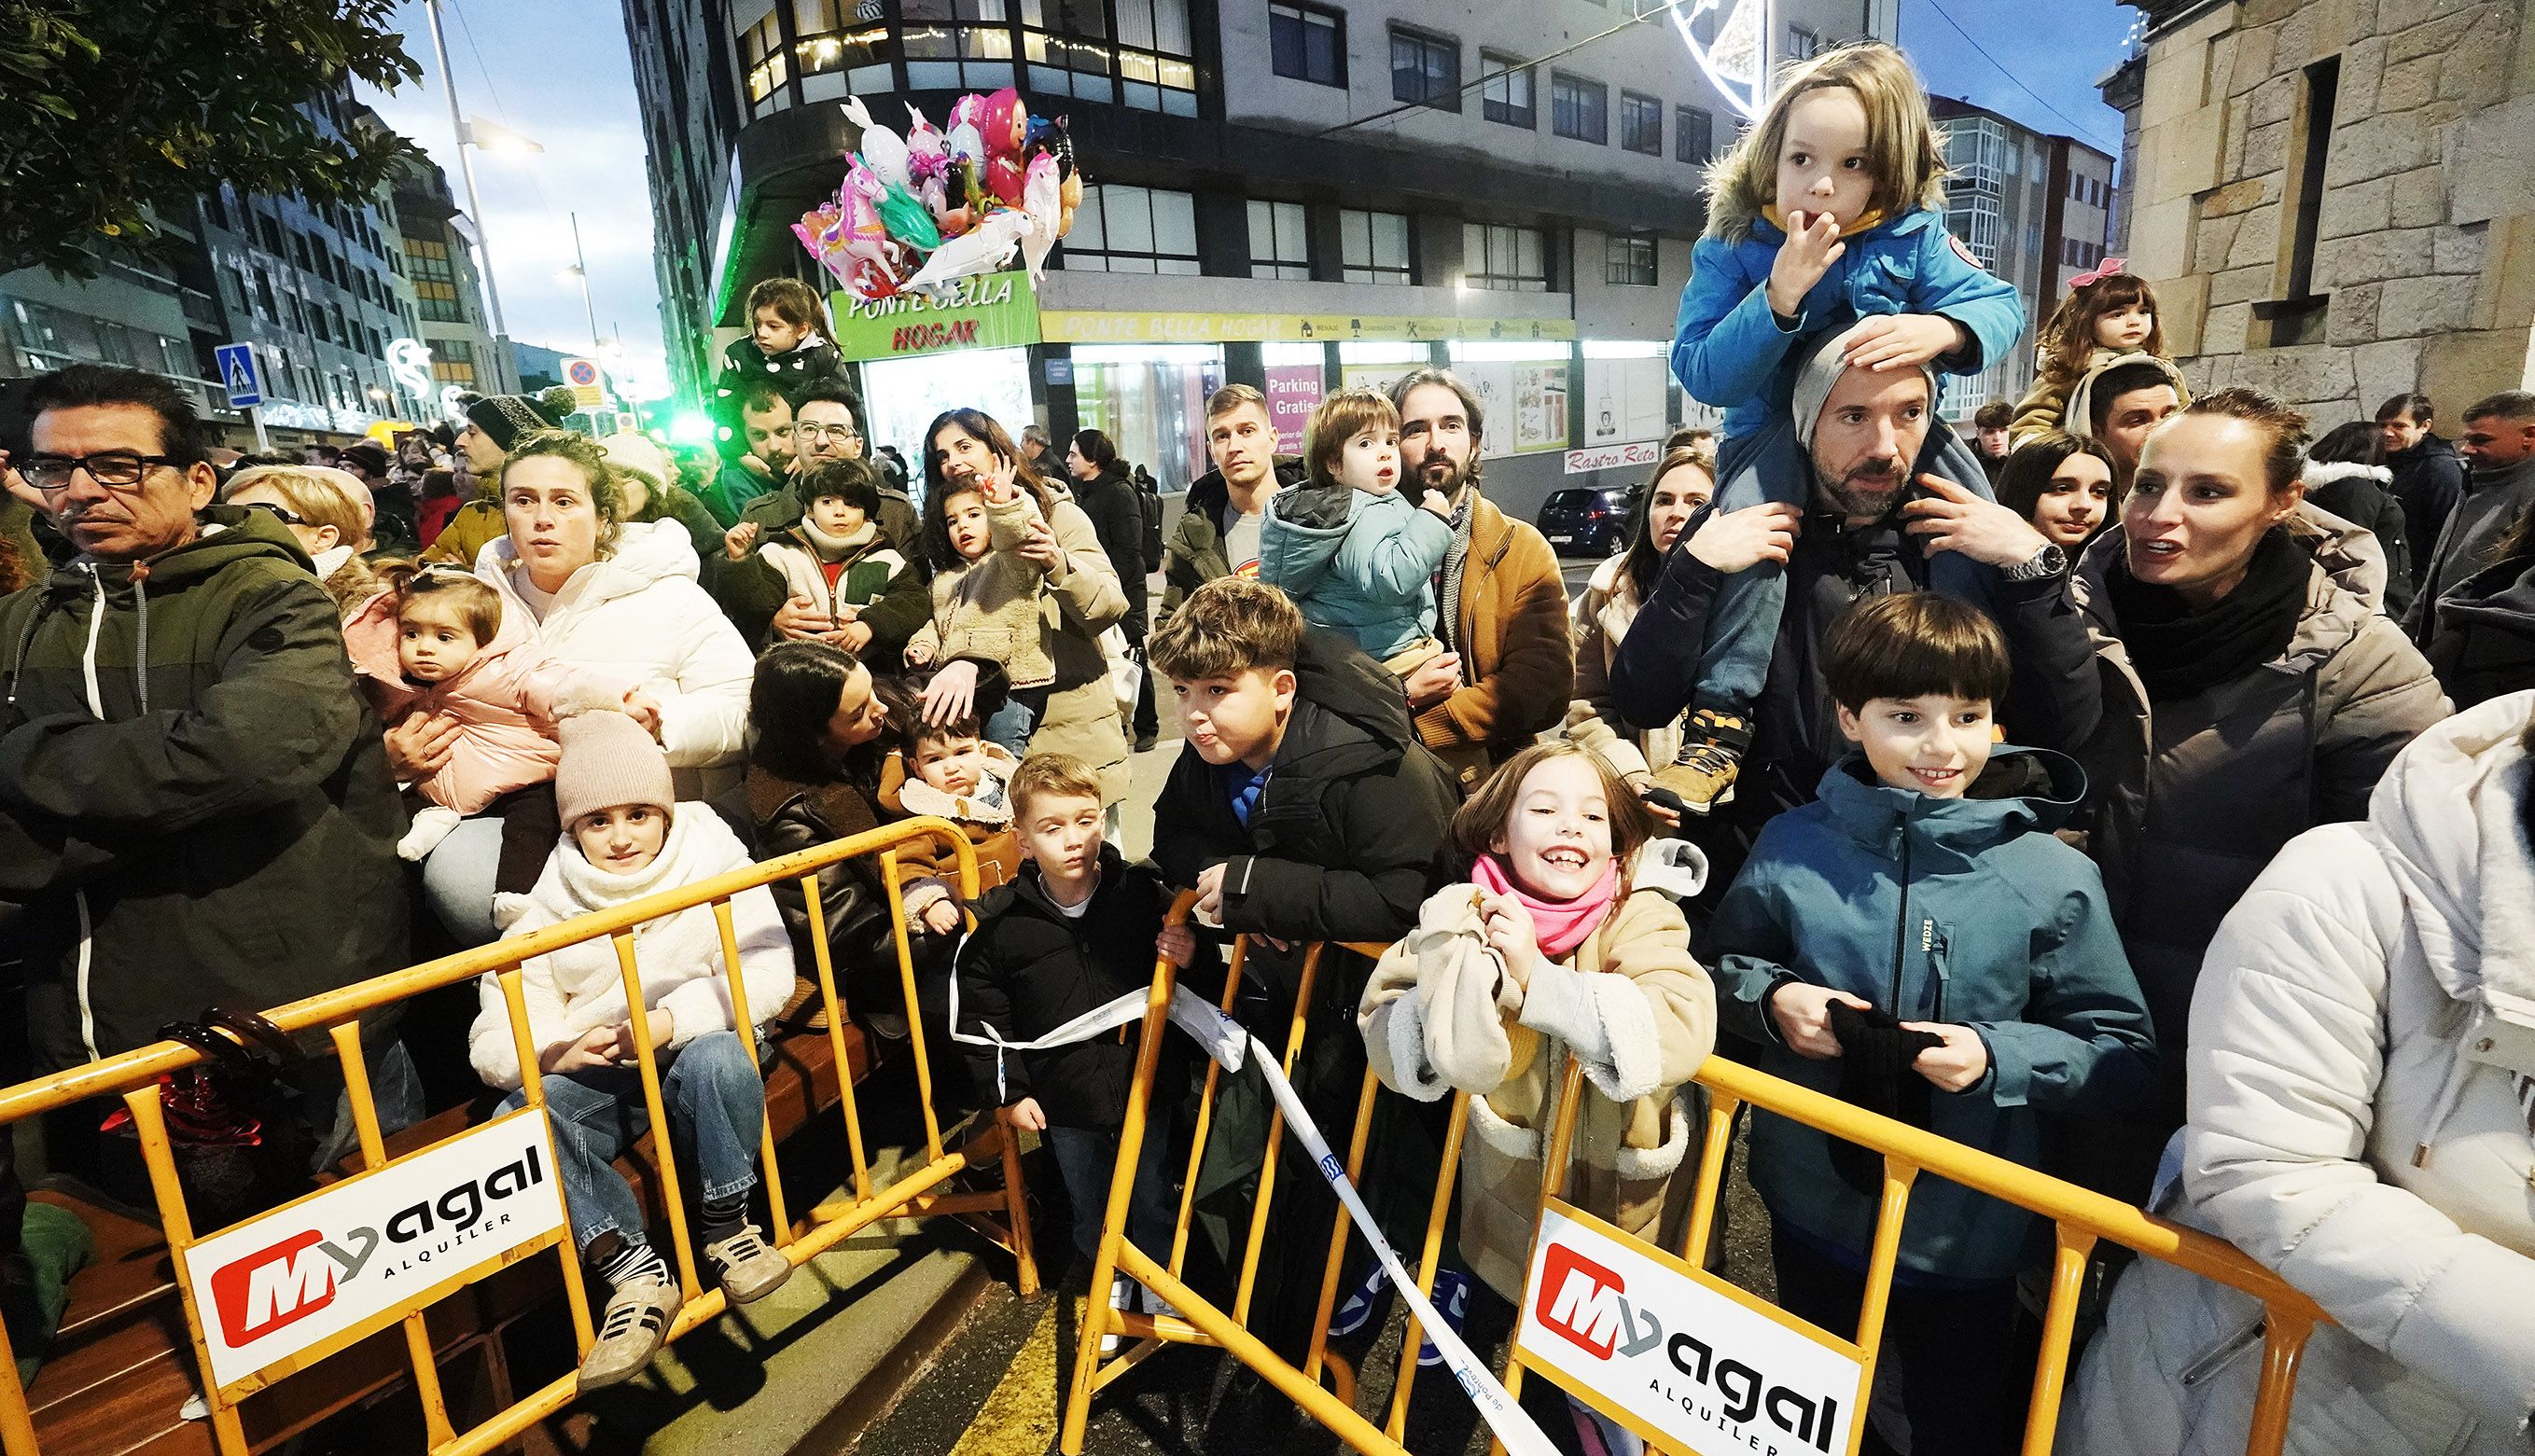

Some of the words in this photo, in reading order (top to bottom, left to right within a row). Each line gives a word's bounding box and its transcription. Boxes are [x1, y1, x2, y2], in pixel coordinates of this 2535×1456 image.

[892, 319, 980, 352] HOGAR
[1064, 316, 1137, 338] PONTE
[1149, 317, 1210, 338] BELLA
[1220, 319, 1282, 338] HOGAR
[1269, 379, 1318, 395] Parking
[1275, 399, 1316, 415] Gratis
[1567, 451, 1619, 470] Rastro
[1623, 445, 1655, 464] Reto
[1922, 920, 1932, 951] WEDZE
[383, 1213, 511, 1280] ALQUILER
[1493, 1399, 1503, 1410] de
[1649, 1379, 1778, 1456] ALQUILER
